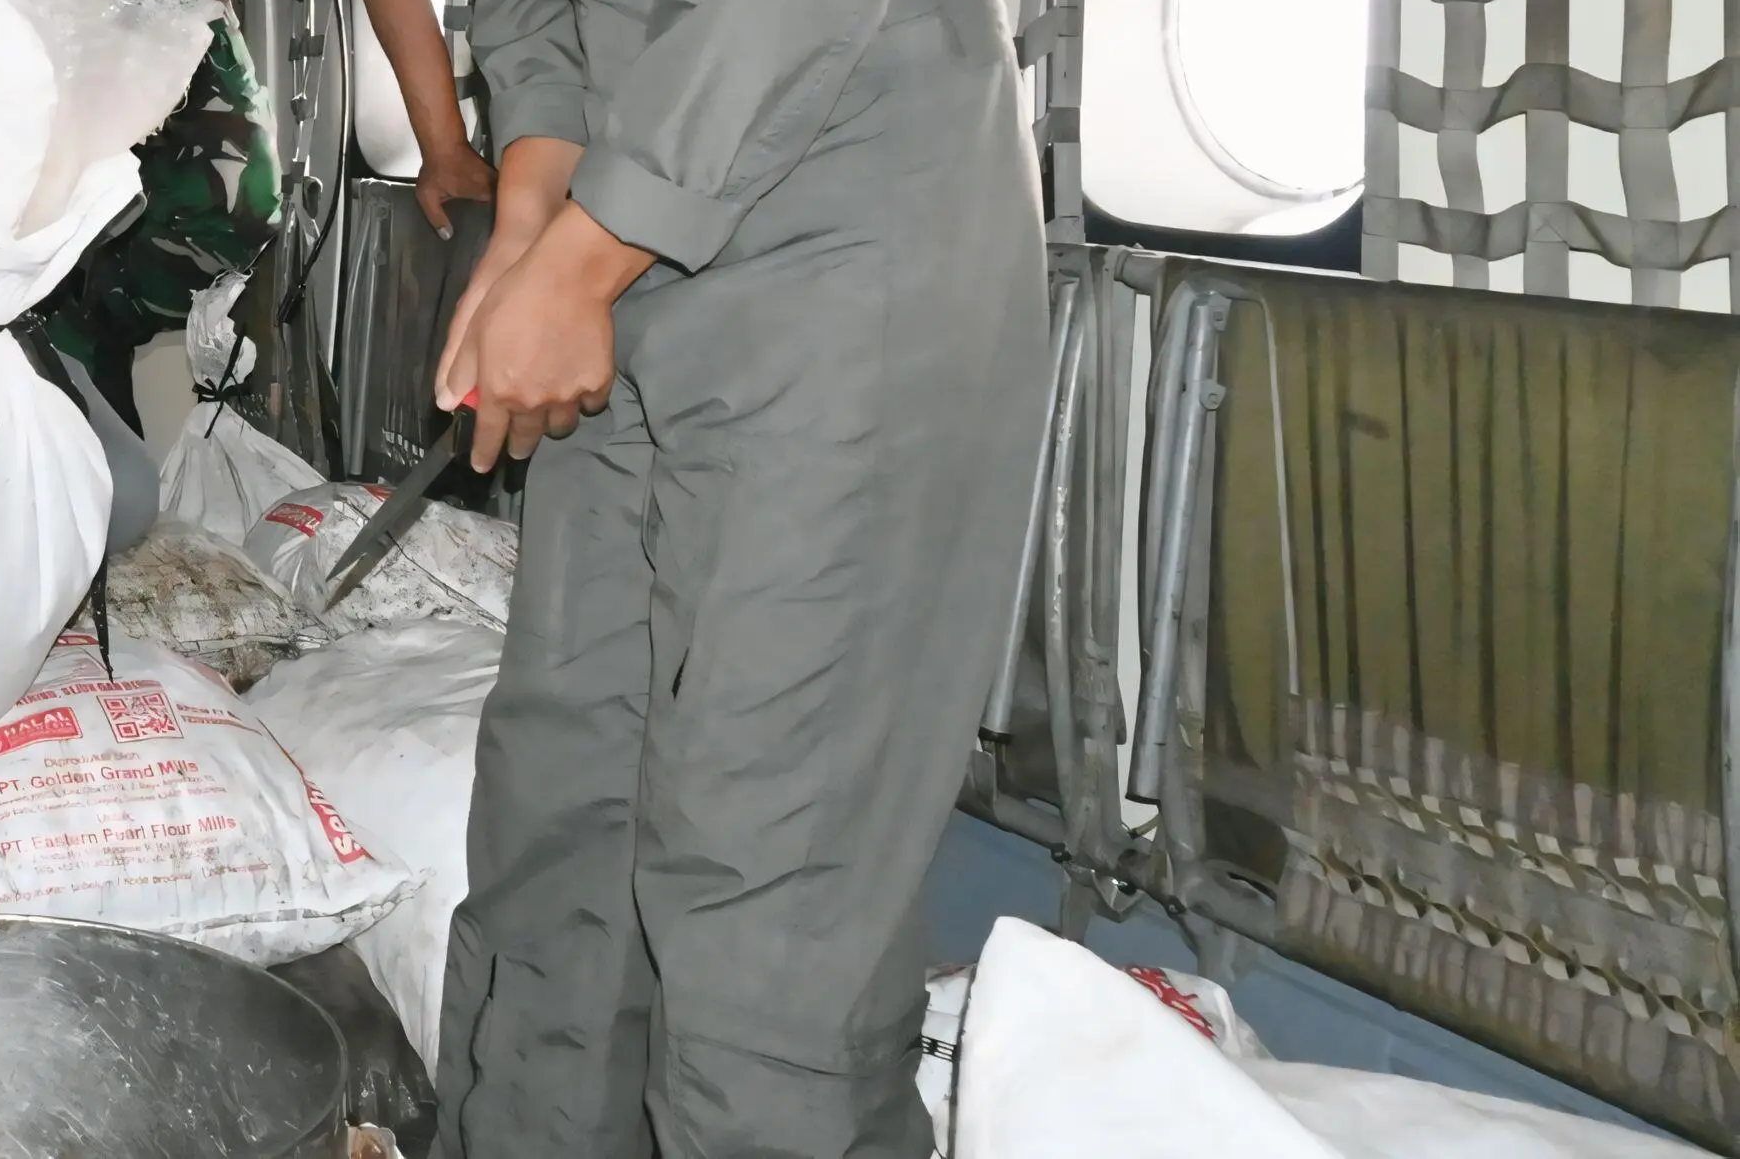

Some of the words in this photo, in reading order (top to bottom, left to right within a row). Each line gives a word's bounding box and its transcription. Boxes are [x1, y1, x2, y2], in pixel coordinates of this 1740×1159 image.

[30, 770, 95, 789] Golden
[100, 763, 154, 780] Grand
[157, 759, 199, 778] Mills
[0, 840, 27, 858] PT.
[32, 832, 98, 850] Eastern
[150, 822, 192, 839] Flour
[198, 815, 237, 833] Mills
